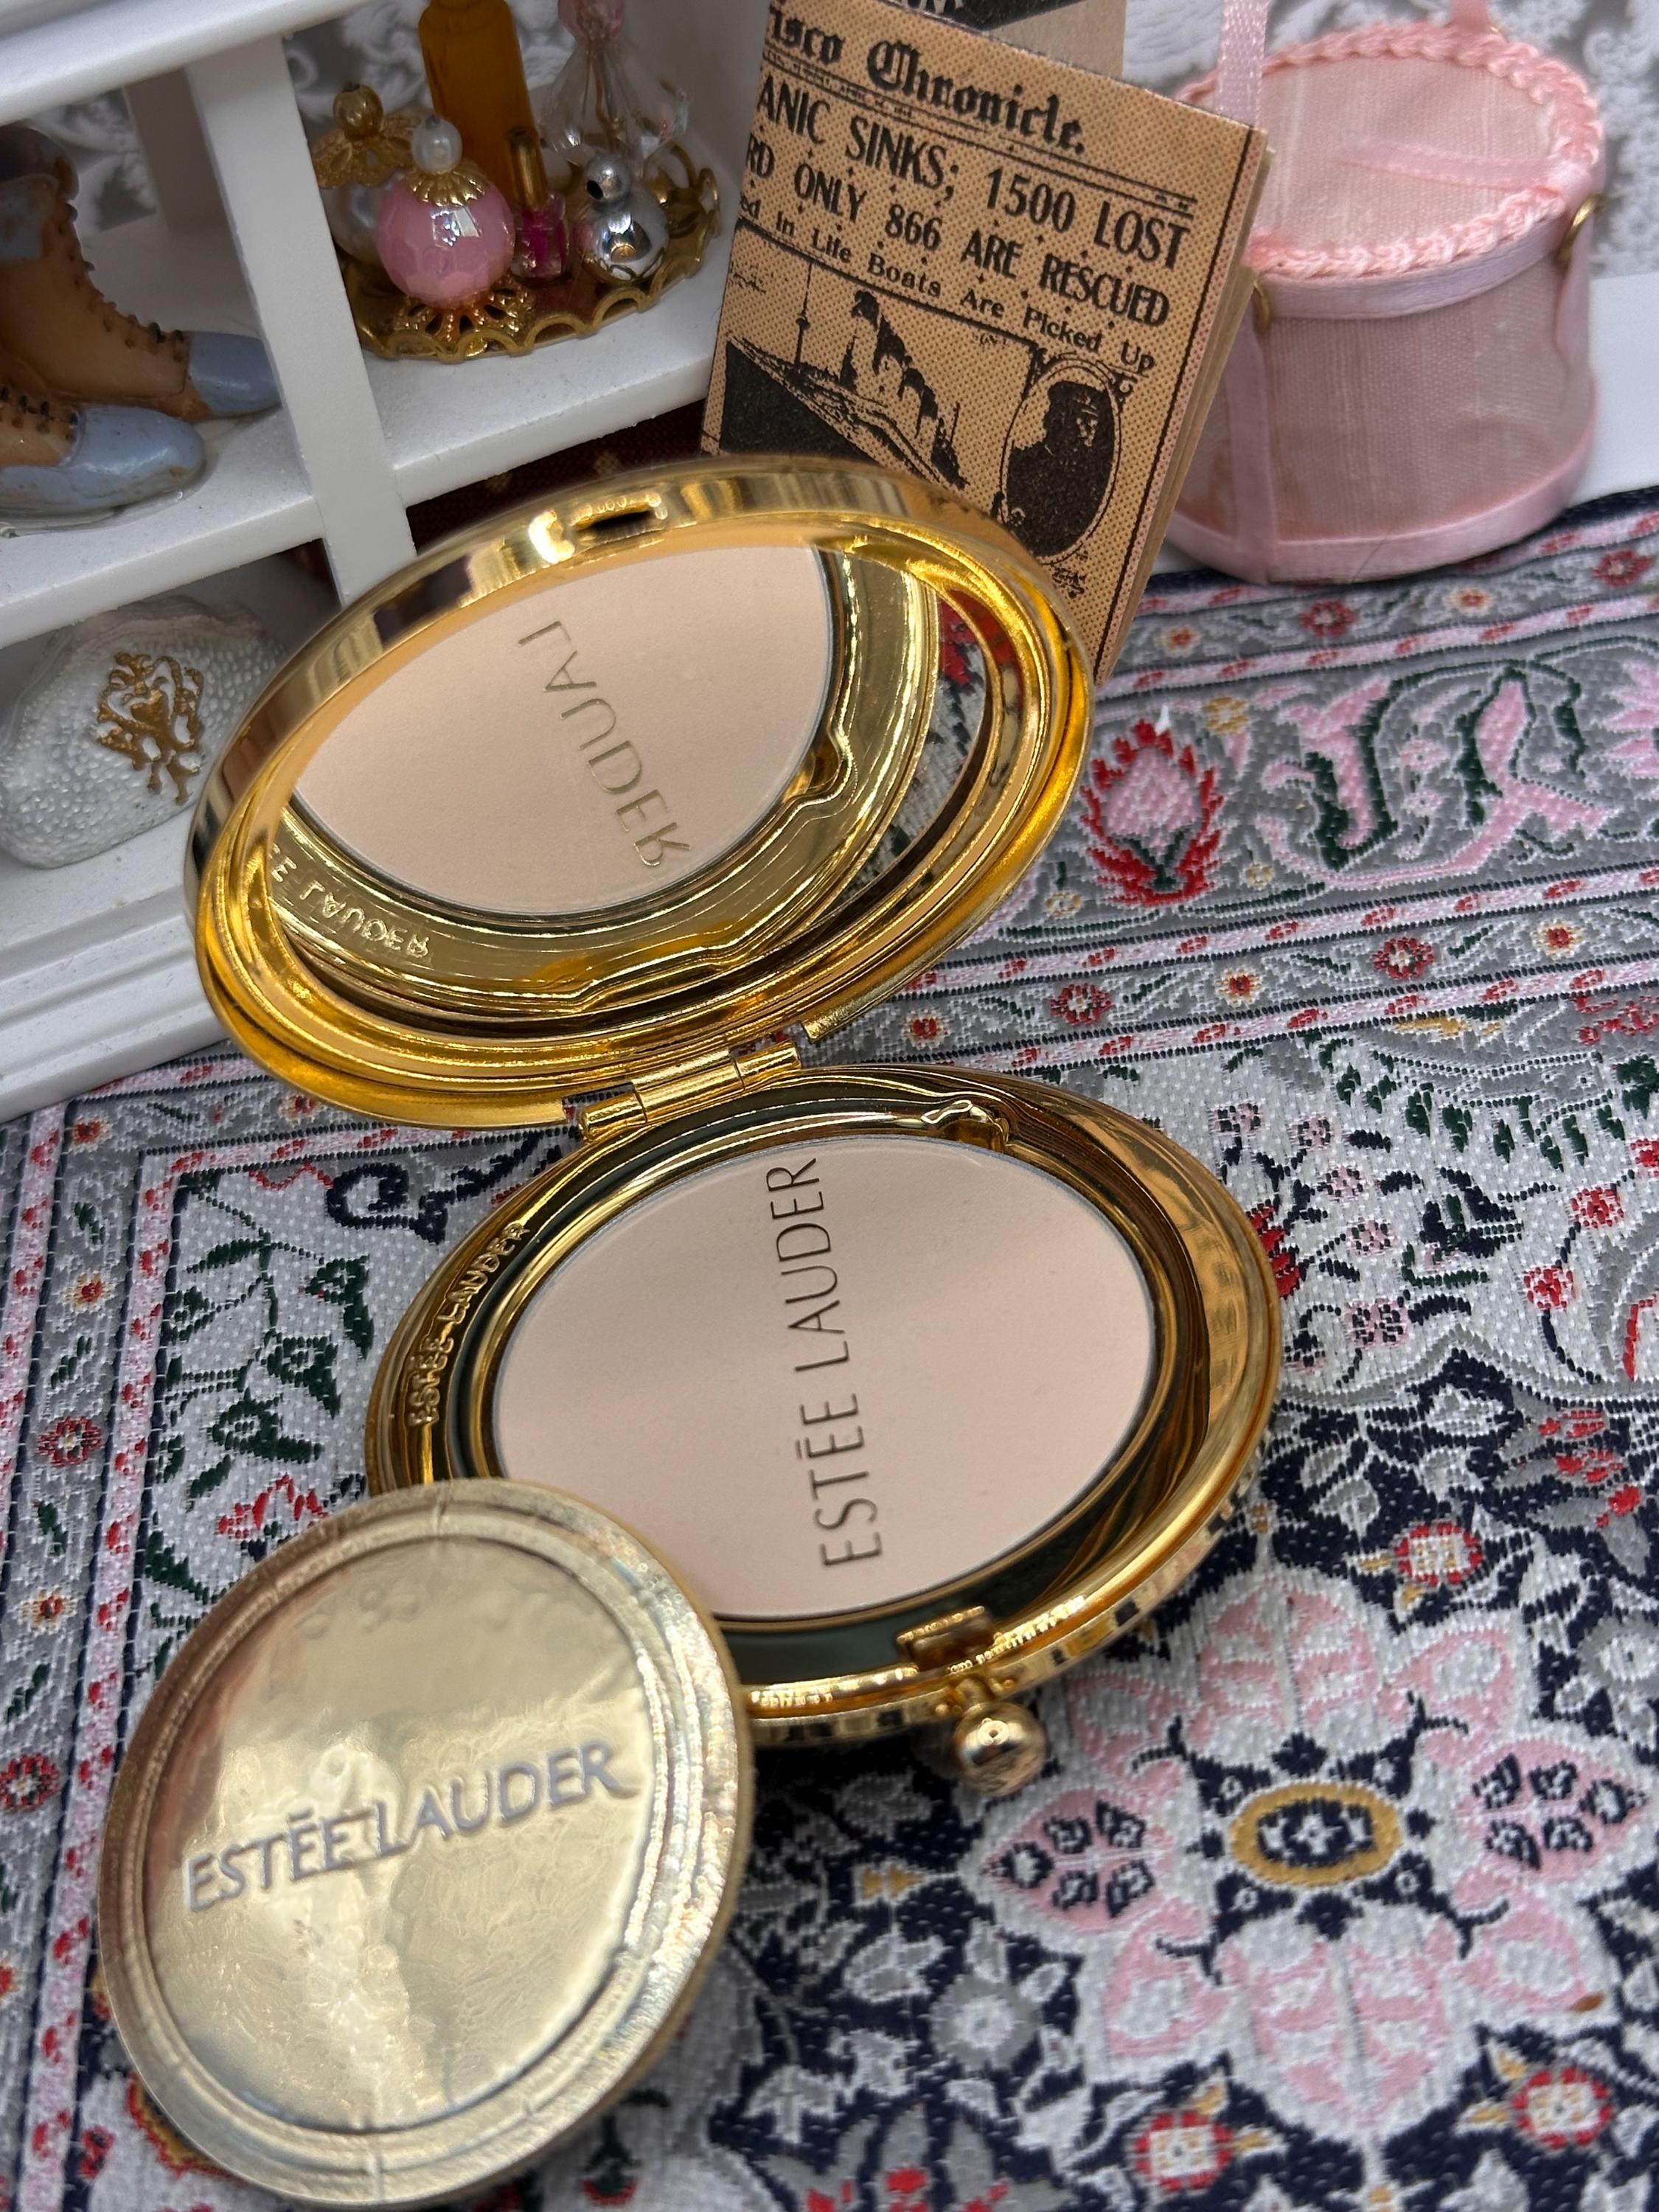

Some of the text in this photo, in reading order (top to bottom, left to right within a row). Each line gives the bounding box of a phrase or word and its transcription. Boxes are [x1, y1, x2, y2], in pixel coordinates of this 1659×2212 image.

[757, 74, 831, 145] ANIC
[846, 114, 959, 201] SINKS;
[987, 168, 1076, 234] 1500
[1093, 201, 1191, 270] LOST
[794, 163, 868, 223] ONLY
[886, 204, 942, 251] 866
[961, 228, 1023, 279] ARE
[1040, 253, 1170, 327] RESCUED
[776, 211, 796, 237] In
[811, 229, 852, 262] Life
[867, 252, 942, 296] Boats
[961, 288, 1005, 319] Are
[1023, 307, 1102, 353] Picked
[437, 1222, 531, 1325] LAUDER
[765, 1158, 850, 1371] LAUDER
[373, 1740, 639, 1857] LAUDER
